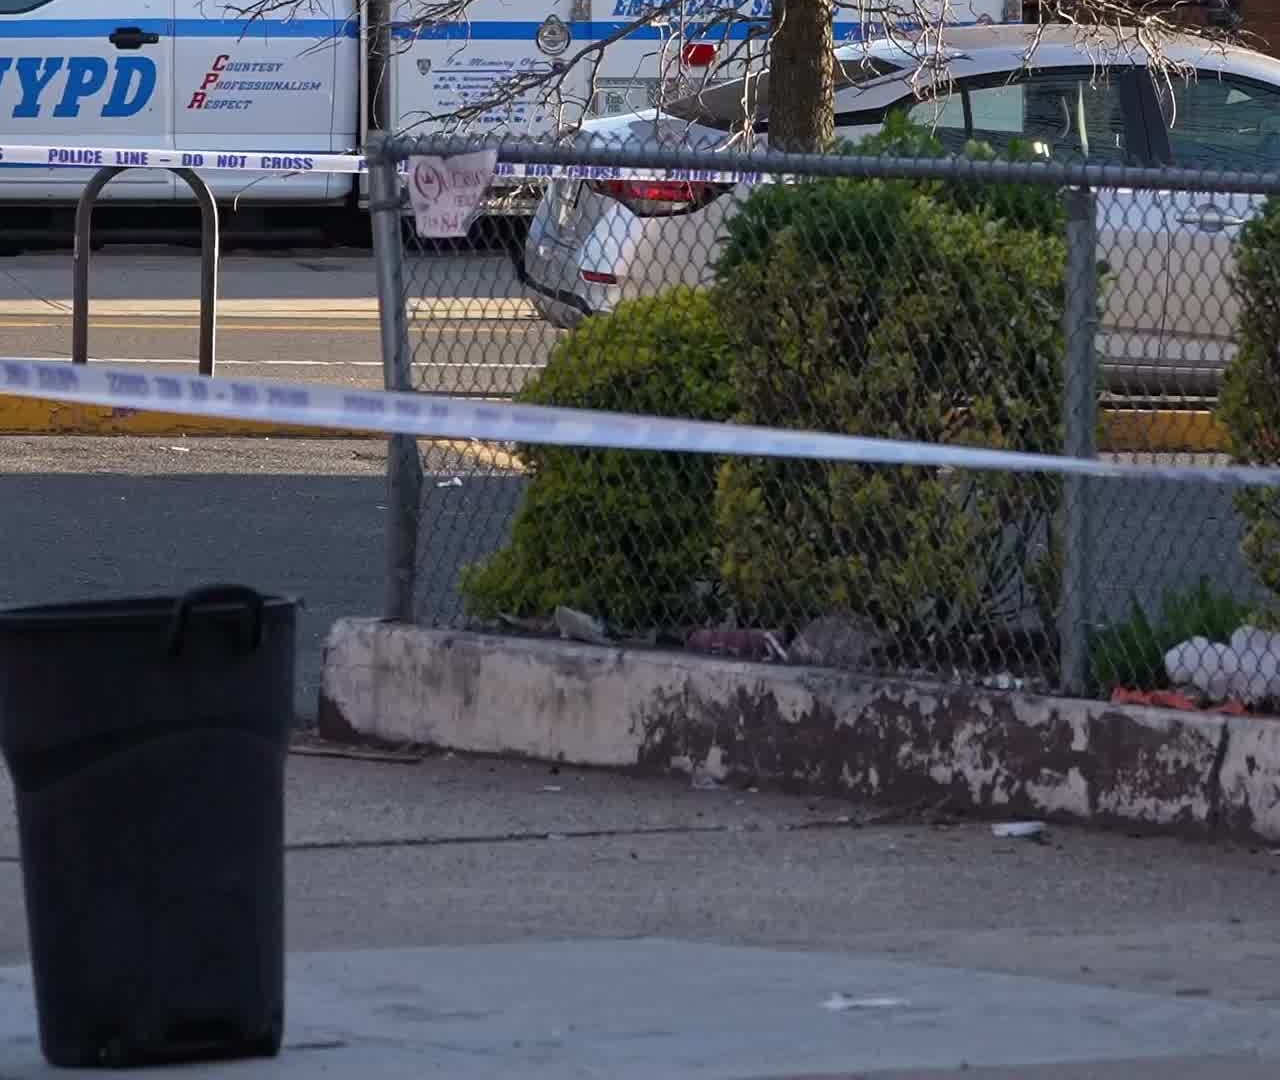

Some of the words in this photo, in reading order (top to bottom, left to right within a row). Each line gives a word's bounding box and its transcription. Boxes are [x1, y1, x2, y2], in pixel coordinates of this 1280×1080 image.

[48, 148, 103, 164] POLICE
[115, 150, 149, 166] LINE
[181, 153, 204, 167] DO
[217, 154, 249, 169] NOT
[261, 155, 314, 170] CROSS
